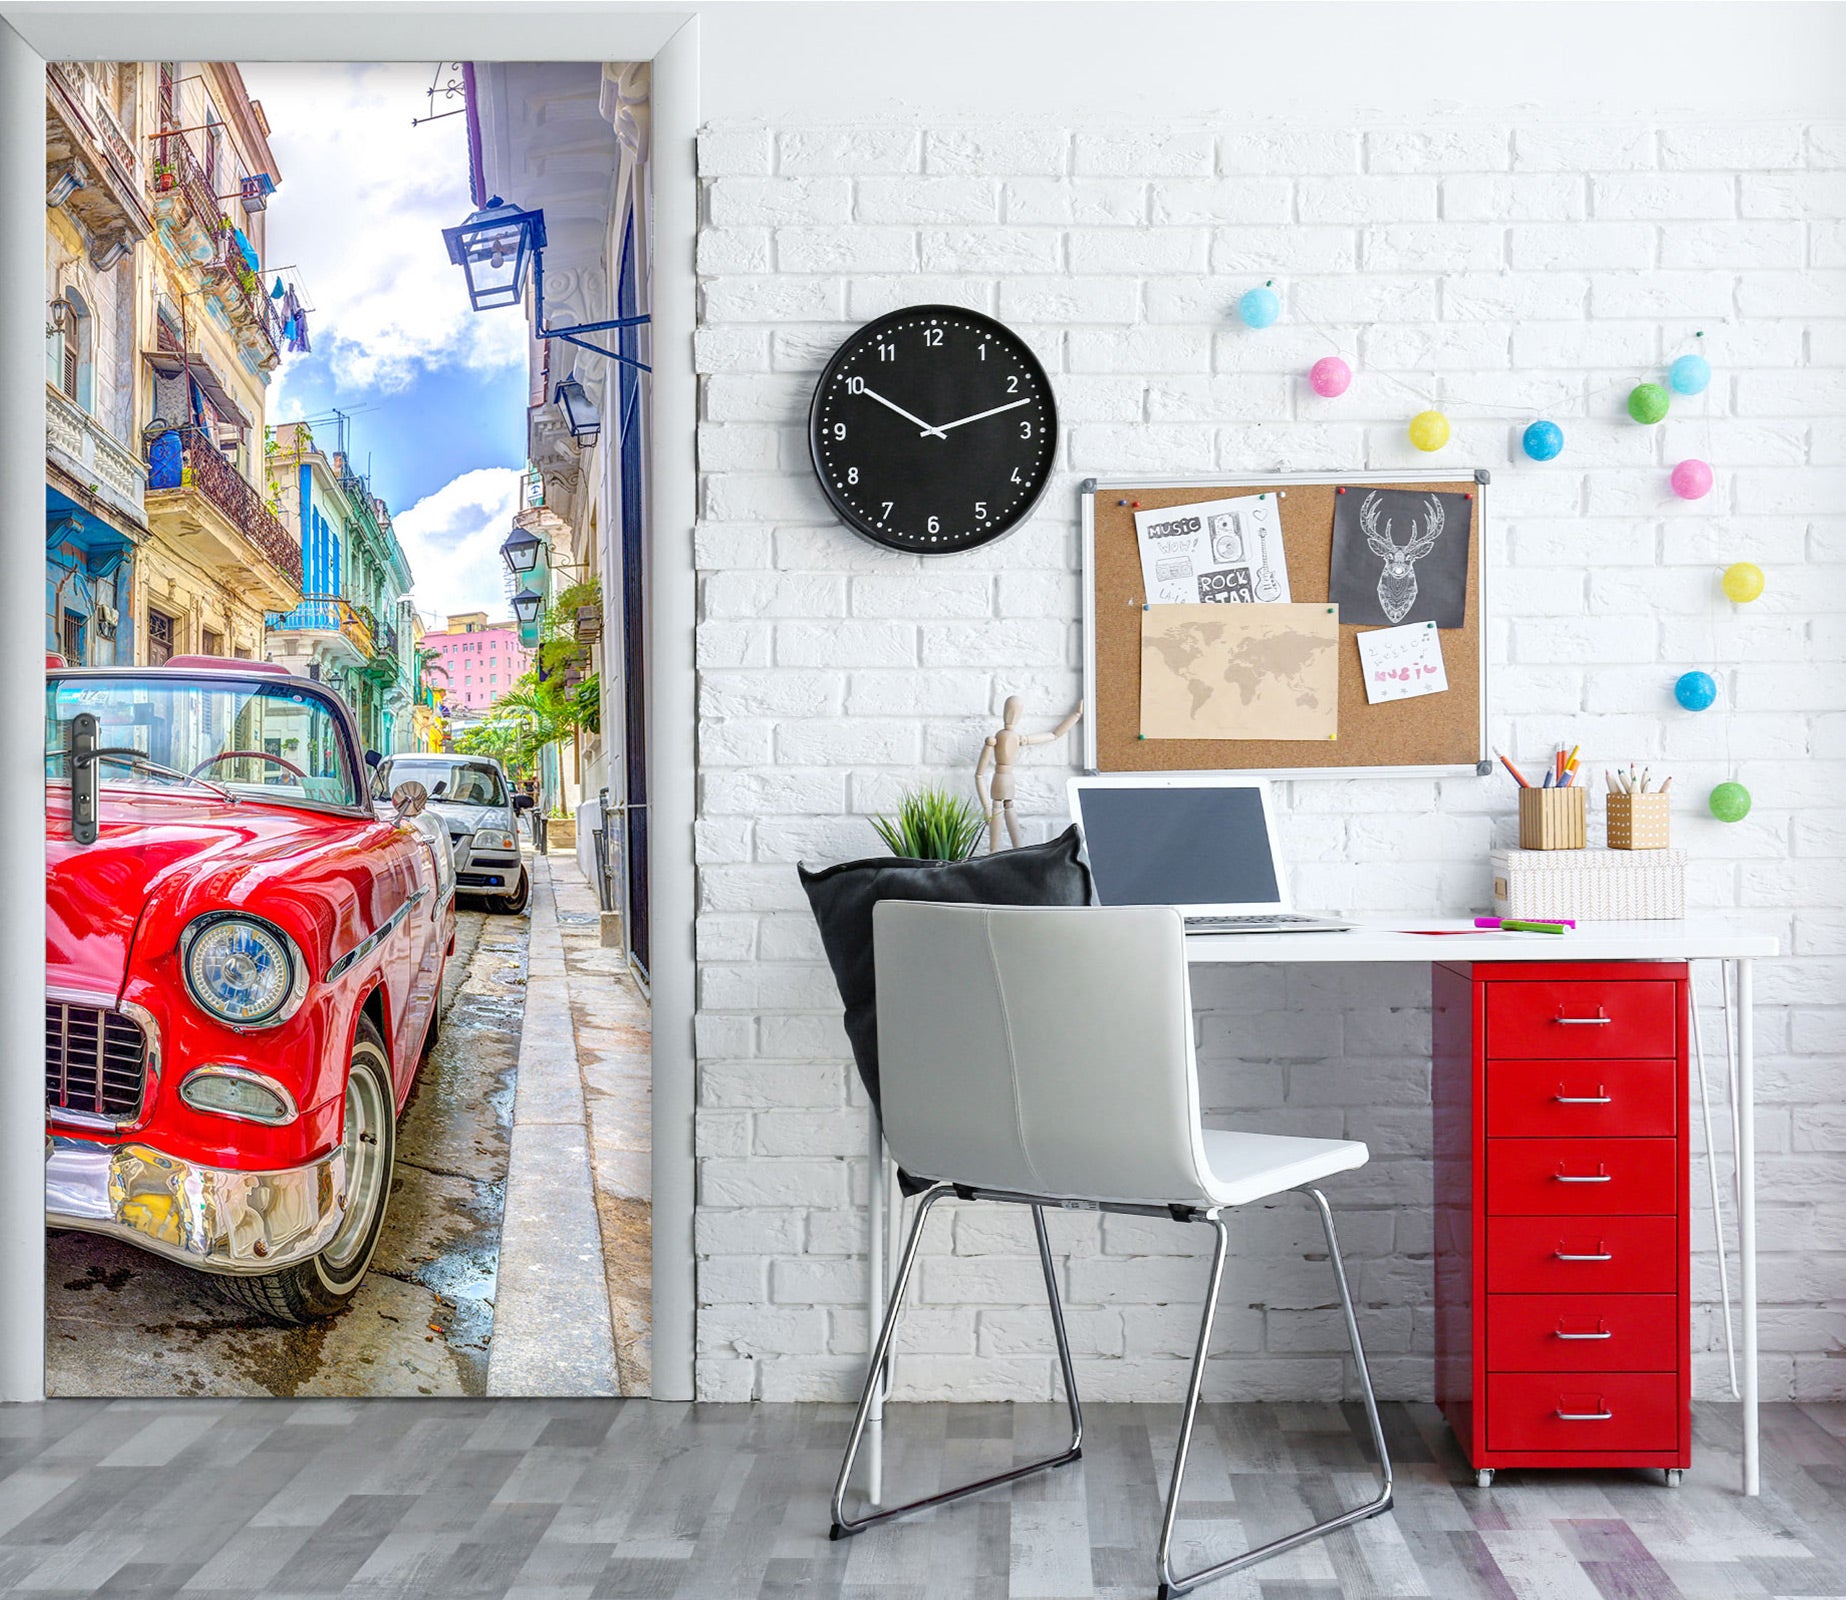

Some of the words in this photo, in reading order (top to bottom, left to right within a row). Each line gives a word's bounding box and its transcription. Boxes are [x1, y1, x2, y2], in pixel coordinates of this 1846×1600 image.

[923, 328, 944, 347] 12
[877, 343, 895, 362] 11
[977, 343, 986, 361] 1
[844, 376, 865, 395] 10
[1006, 375, 1019, 393] 2
[833, 422, 847, 441] 9
[1019, 420, 1032, 440] 3
[847, 466, 859, 485] 8
[1010, 466, 1022, 485] 4
[881, 501, 894, 520] 7
[975, 501, 987, 520] 5
[927, 515, 940, 534] 6
[1200, 571, 1249, 592] ROCK
[1204, 587, 1251, 603] STAR
[304, 788, 346, 805] TAXI
